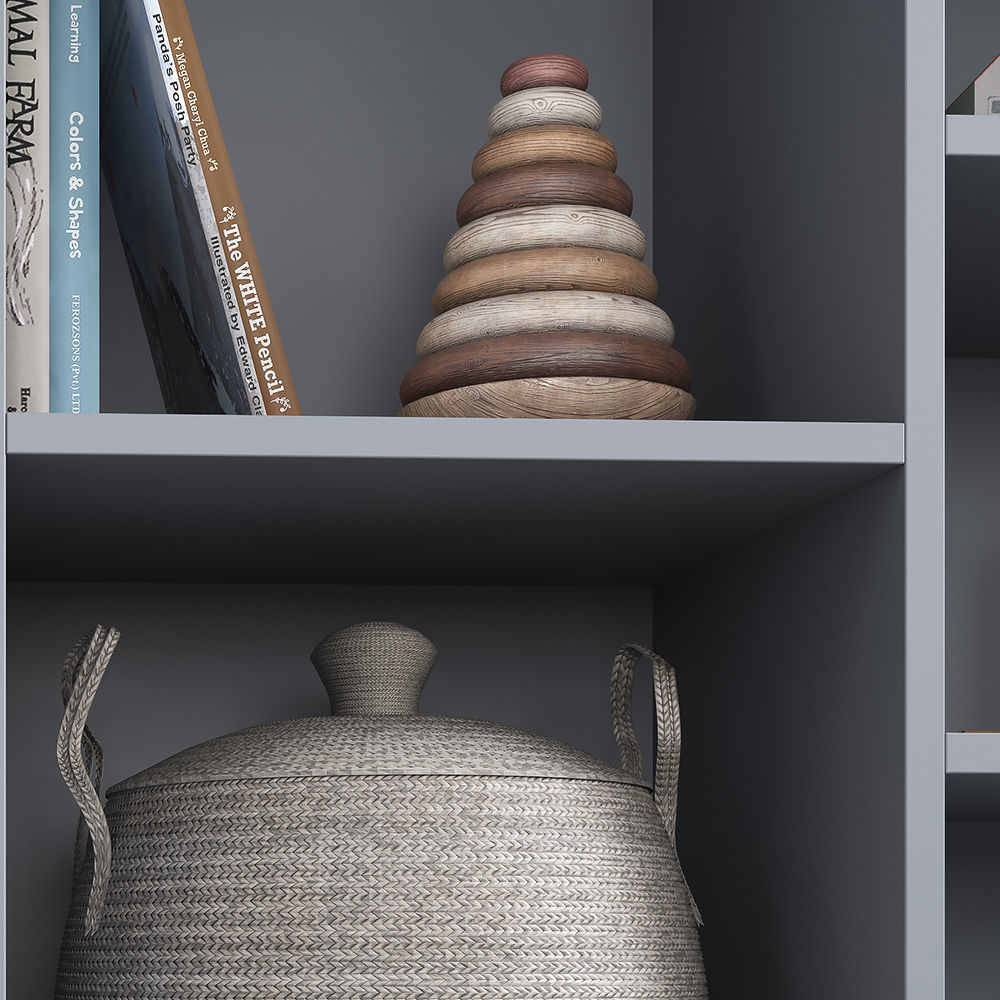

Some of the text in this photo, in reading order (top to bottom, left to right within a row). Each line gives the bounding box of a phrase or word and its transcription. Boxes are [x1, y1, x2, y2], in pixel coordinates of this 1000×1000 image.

[68, 5, 82, 62] Learning
[6, 78, 39, 168] FARM
[152, 13, 196, 166] Panda's Posh Party
[176, 53, 210, 156] Megan Cheryl Chua
[66, 111, 84, 259] Colors & Shapes
[71, 294, 81, 361] FEROZSONS
[210, 236, 236, 310] Illustrated
[231, 313, 240, 331] by
[236, 336, 257, 391] Edward
[223, 223, 284, 396] The WHITE Pencil
[71, 393, 80, 414] LTD
